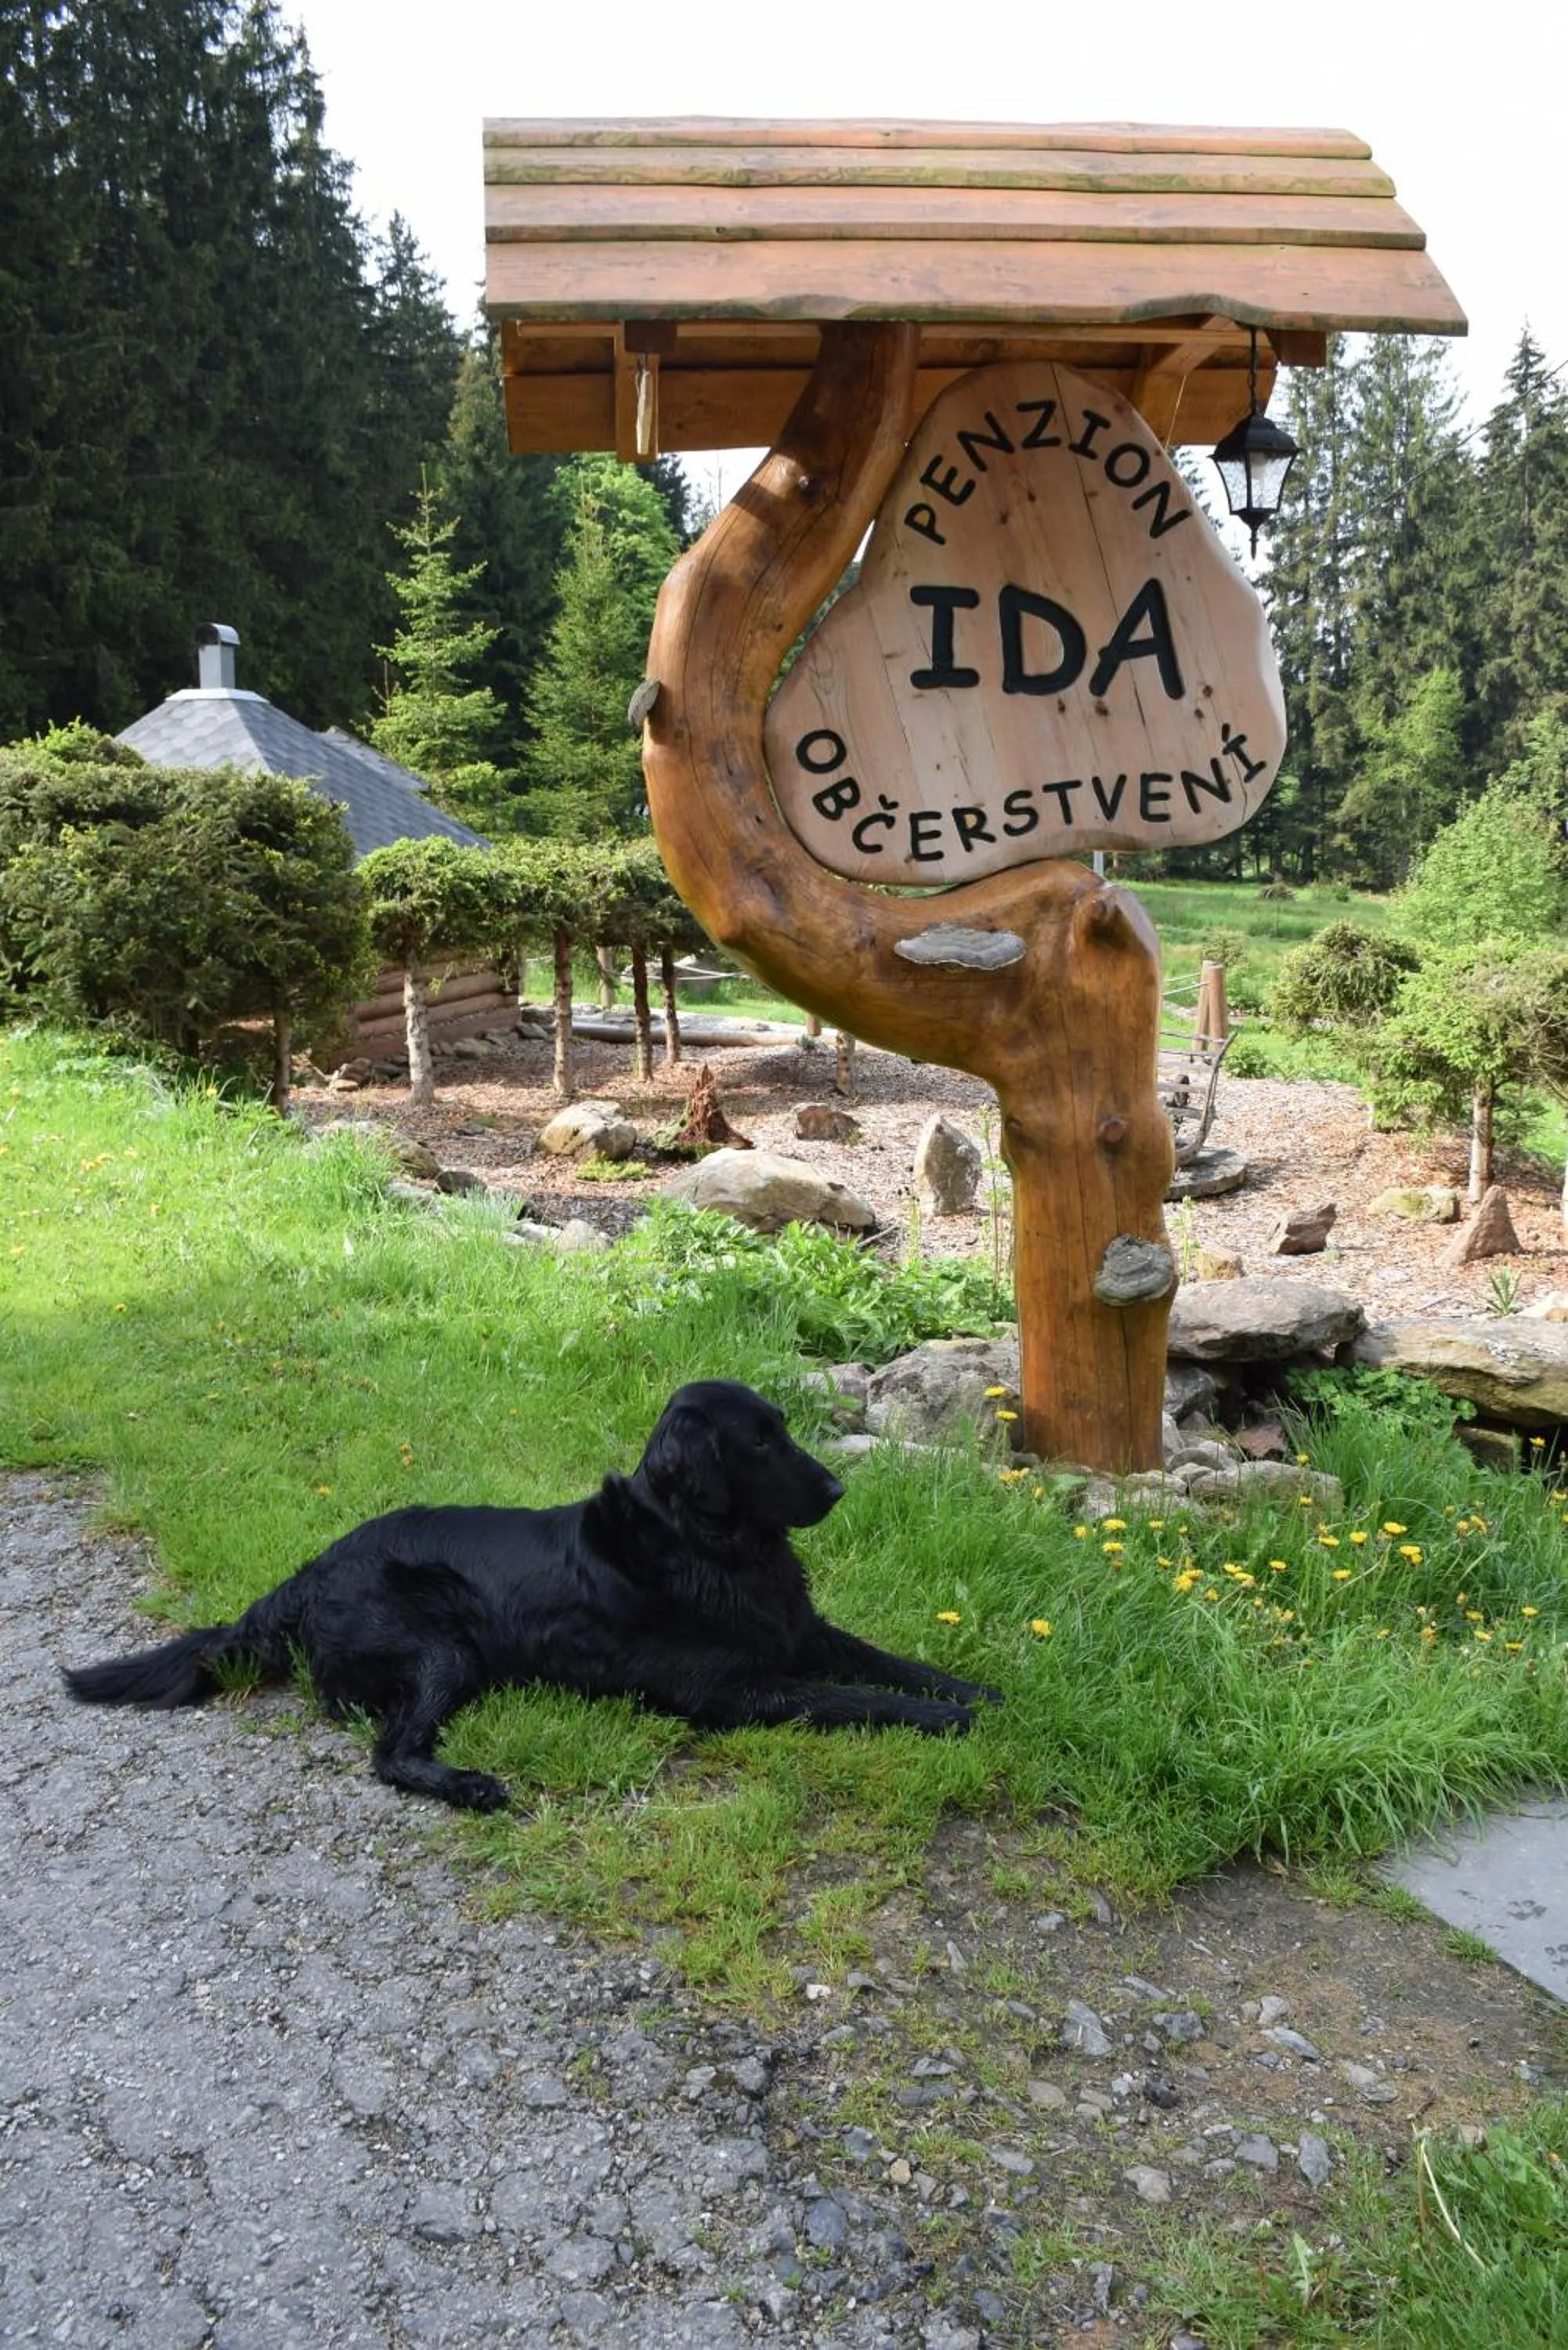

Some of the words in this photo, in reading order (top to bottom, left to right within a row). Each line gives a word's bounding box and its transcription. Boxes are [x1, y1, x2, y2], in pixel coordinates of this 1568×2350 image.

[904, 400, 1192, 545] PENZION
[910, 578, 1185, 700] IDA
[796, 722, 1266, 861] OBČERSTVENÍ
